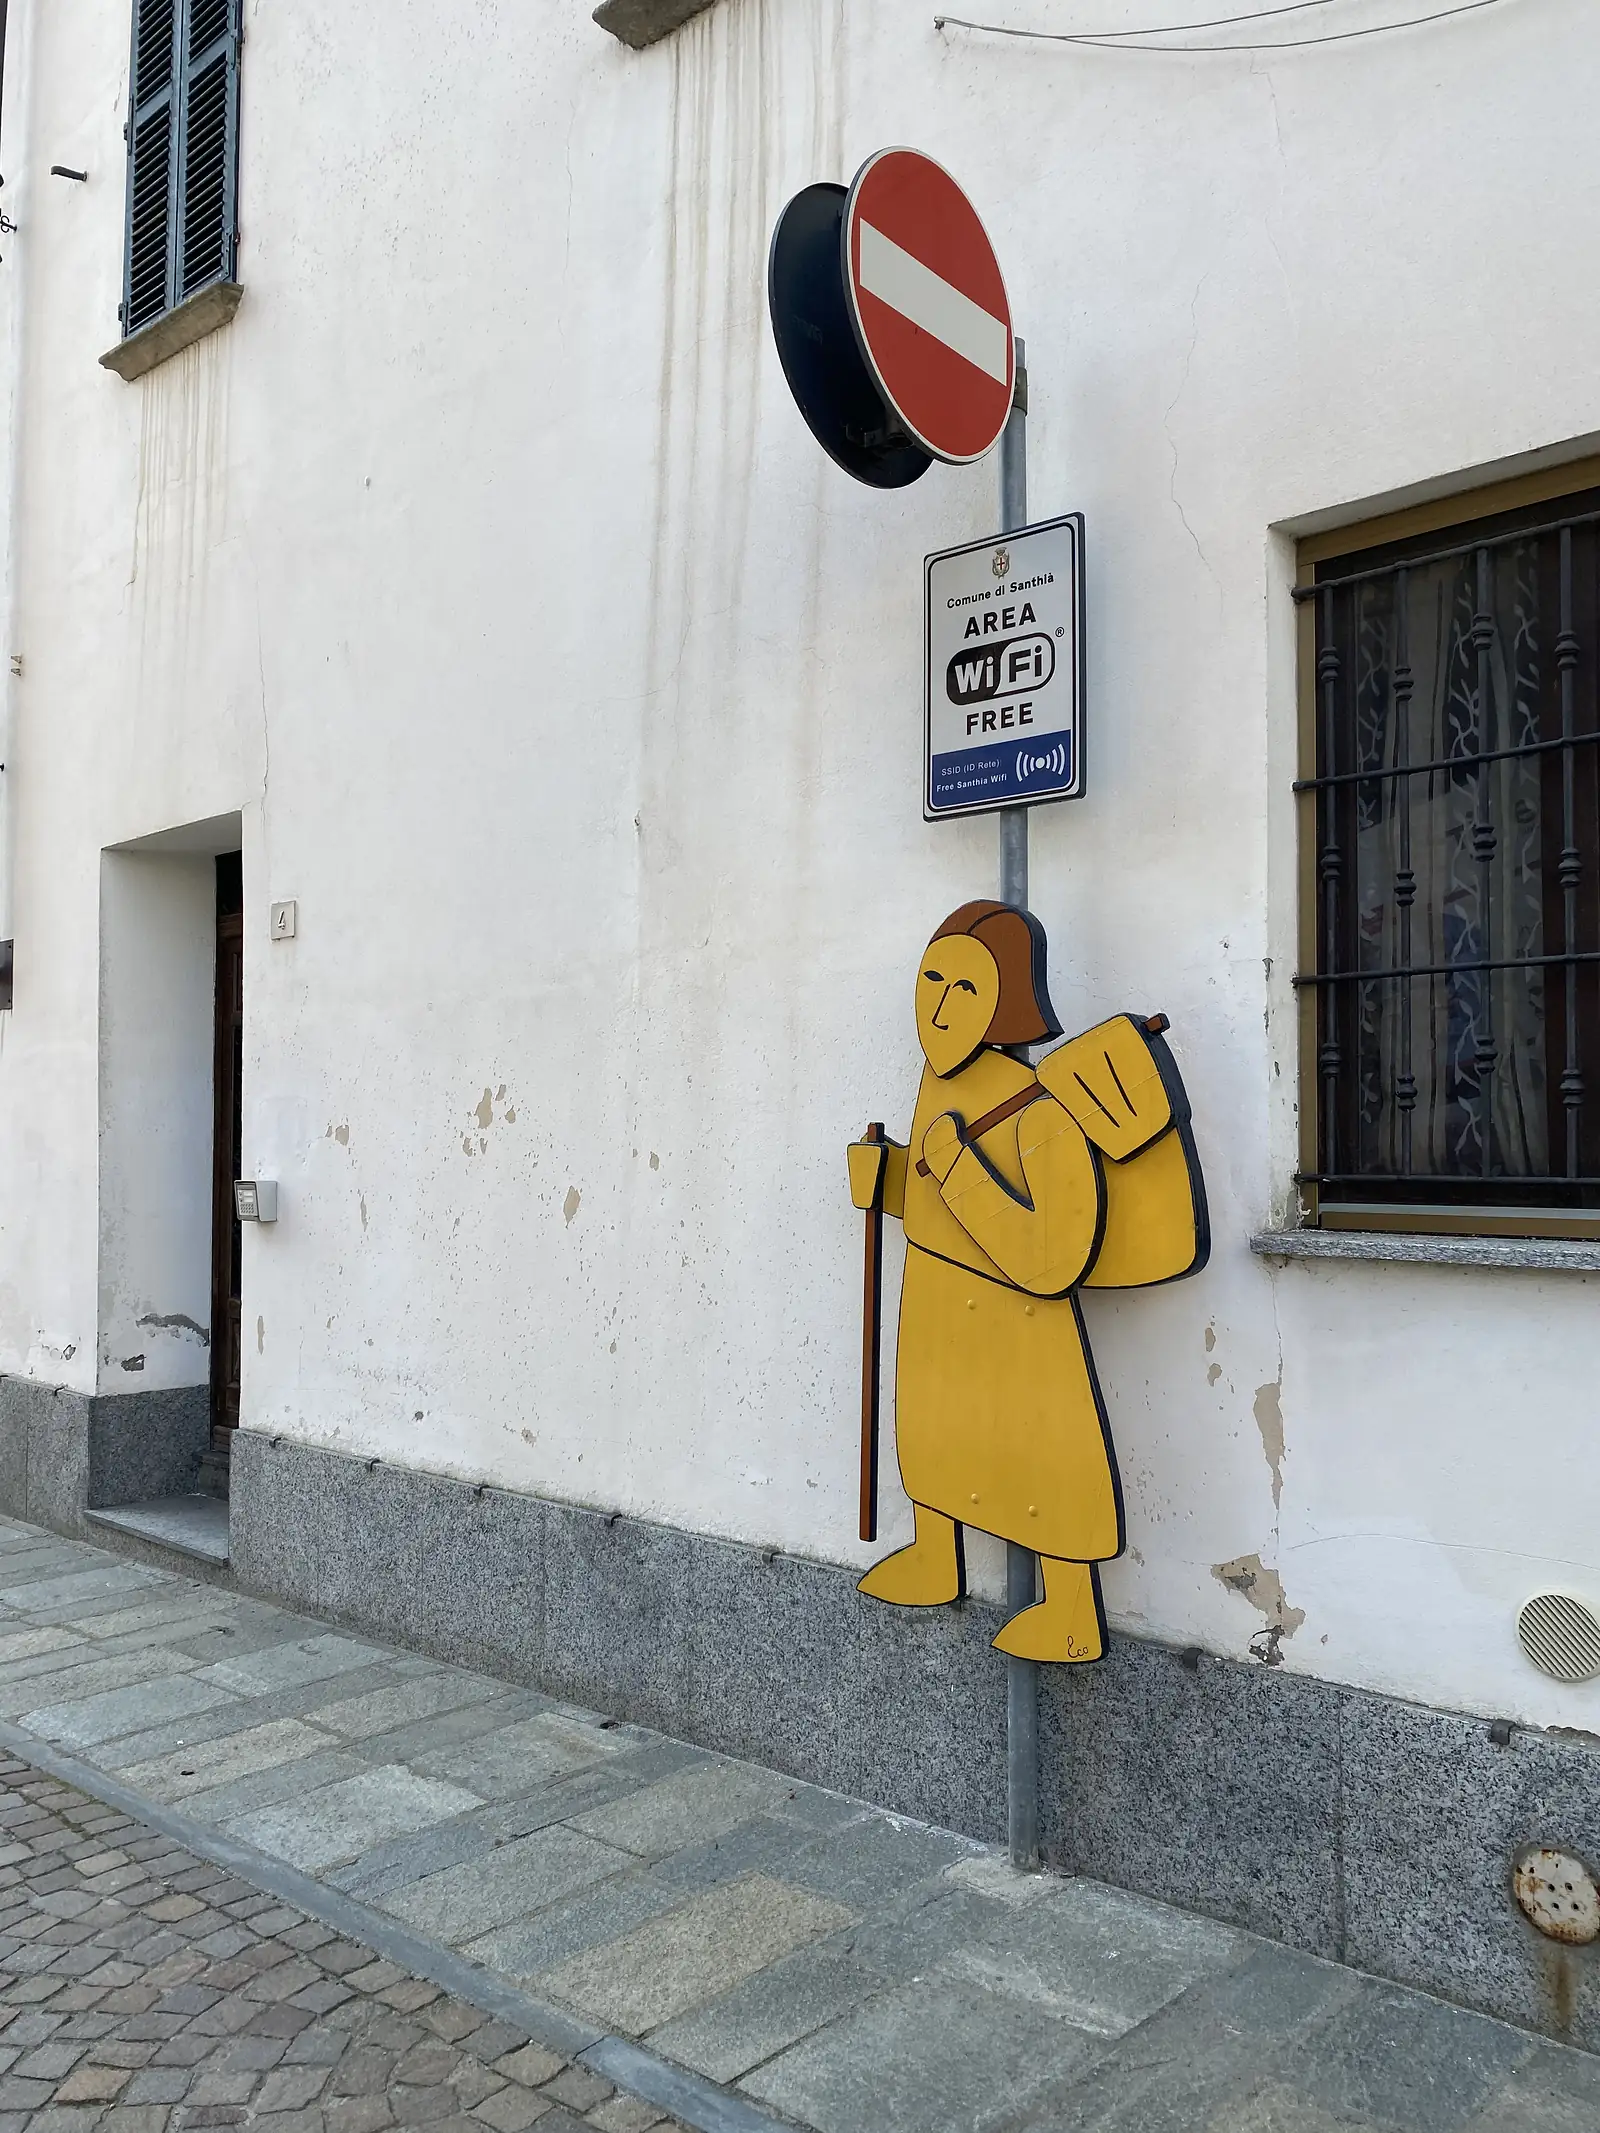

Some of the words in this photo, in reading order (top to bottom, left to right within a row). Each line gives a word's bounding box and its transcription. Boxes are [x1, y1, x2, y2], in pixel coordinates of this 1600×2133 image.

[947, 591, 991, 608] Comune
[995, 585, 1005, 596] di
[1010, 572, 1054, 593] Santhià
[964, 602, 1036, 639] AREA
[954, 645, 1042, 694] WiFi
[966, 702, 1033, 735] FREE
[936, 784, 954, 792] Free
[957, 777, 988, 789] Santhia
[990, 773, 1007, 783] Wifi
[941, 766, 961, 776] SSID
[963, 763, 975, 773] (ID
[277, 910, 286, 930] 4
